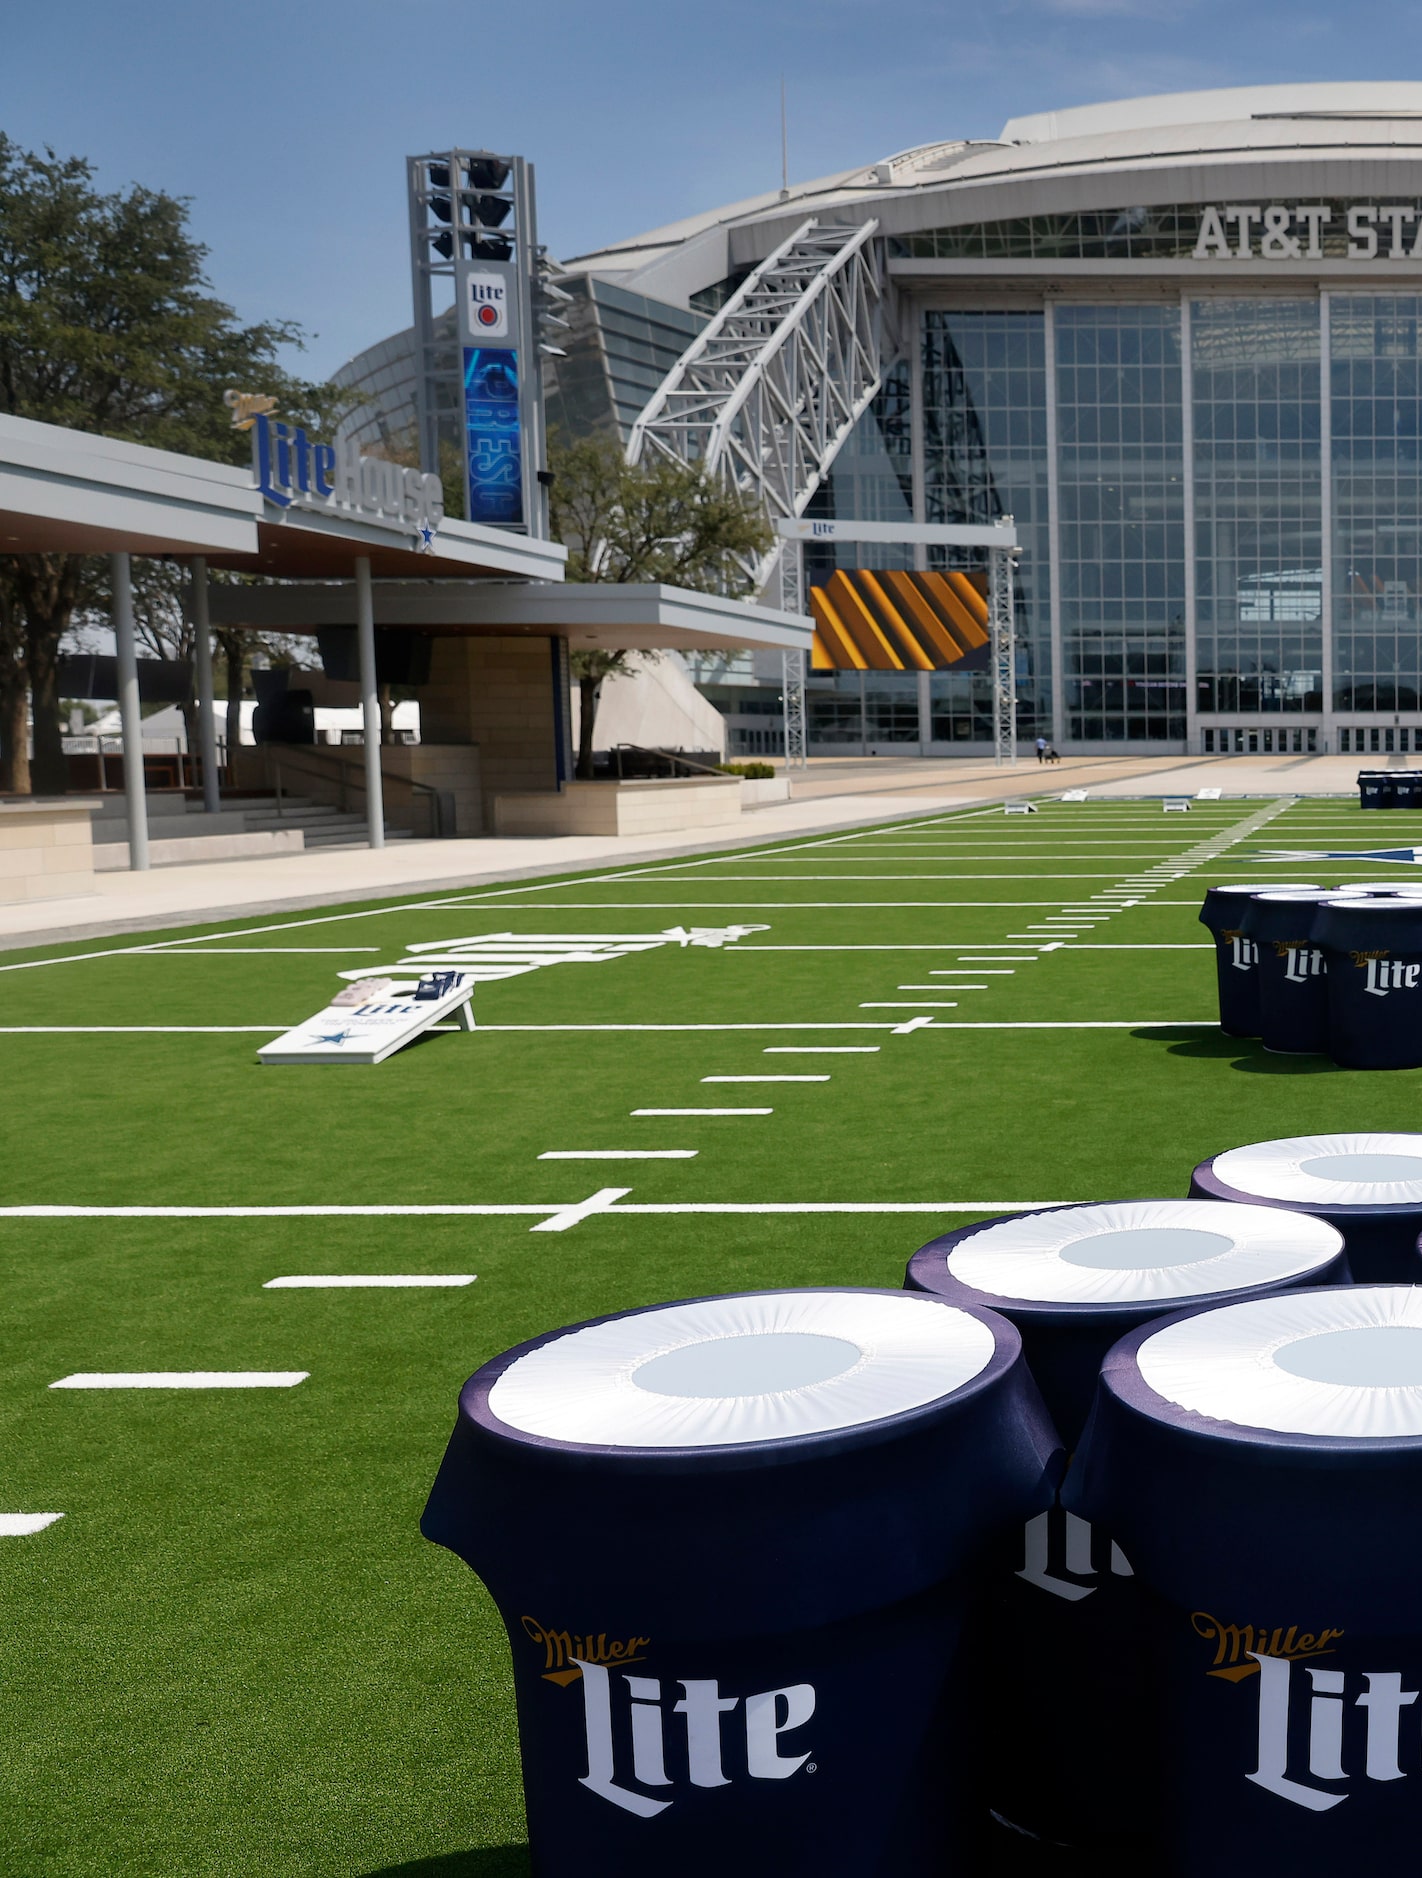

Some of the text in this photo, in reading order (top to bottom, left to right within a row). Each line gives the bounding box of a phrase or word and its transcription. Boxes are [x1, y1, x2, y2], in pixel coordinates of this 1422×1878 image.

[1192, 206, 1331, 259] AT&T
[471, 283, 503, 303] Lite
[252, 412, 335, 509] Lite
[813, 522, 835, 536] Lite
[1284, 948, 1328, 983] Lit
[1364, 958, 1420, 997] Lite
[351, 1003, 423, 1017] Lite
[521, 1615, 650, 1680] Miller
[1191, 1611, 1345, 1678] Miller
[568, 1656, 816, 1818] Lite
